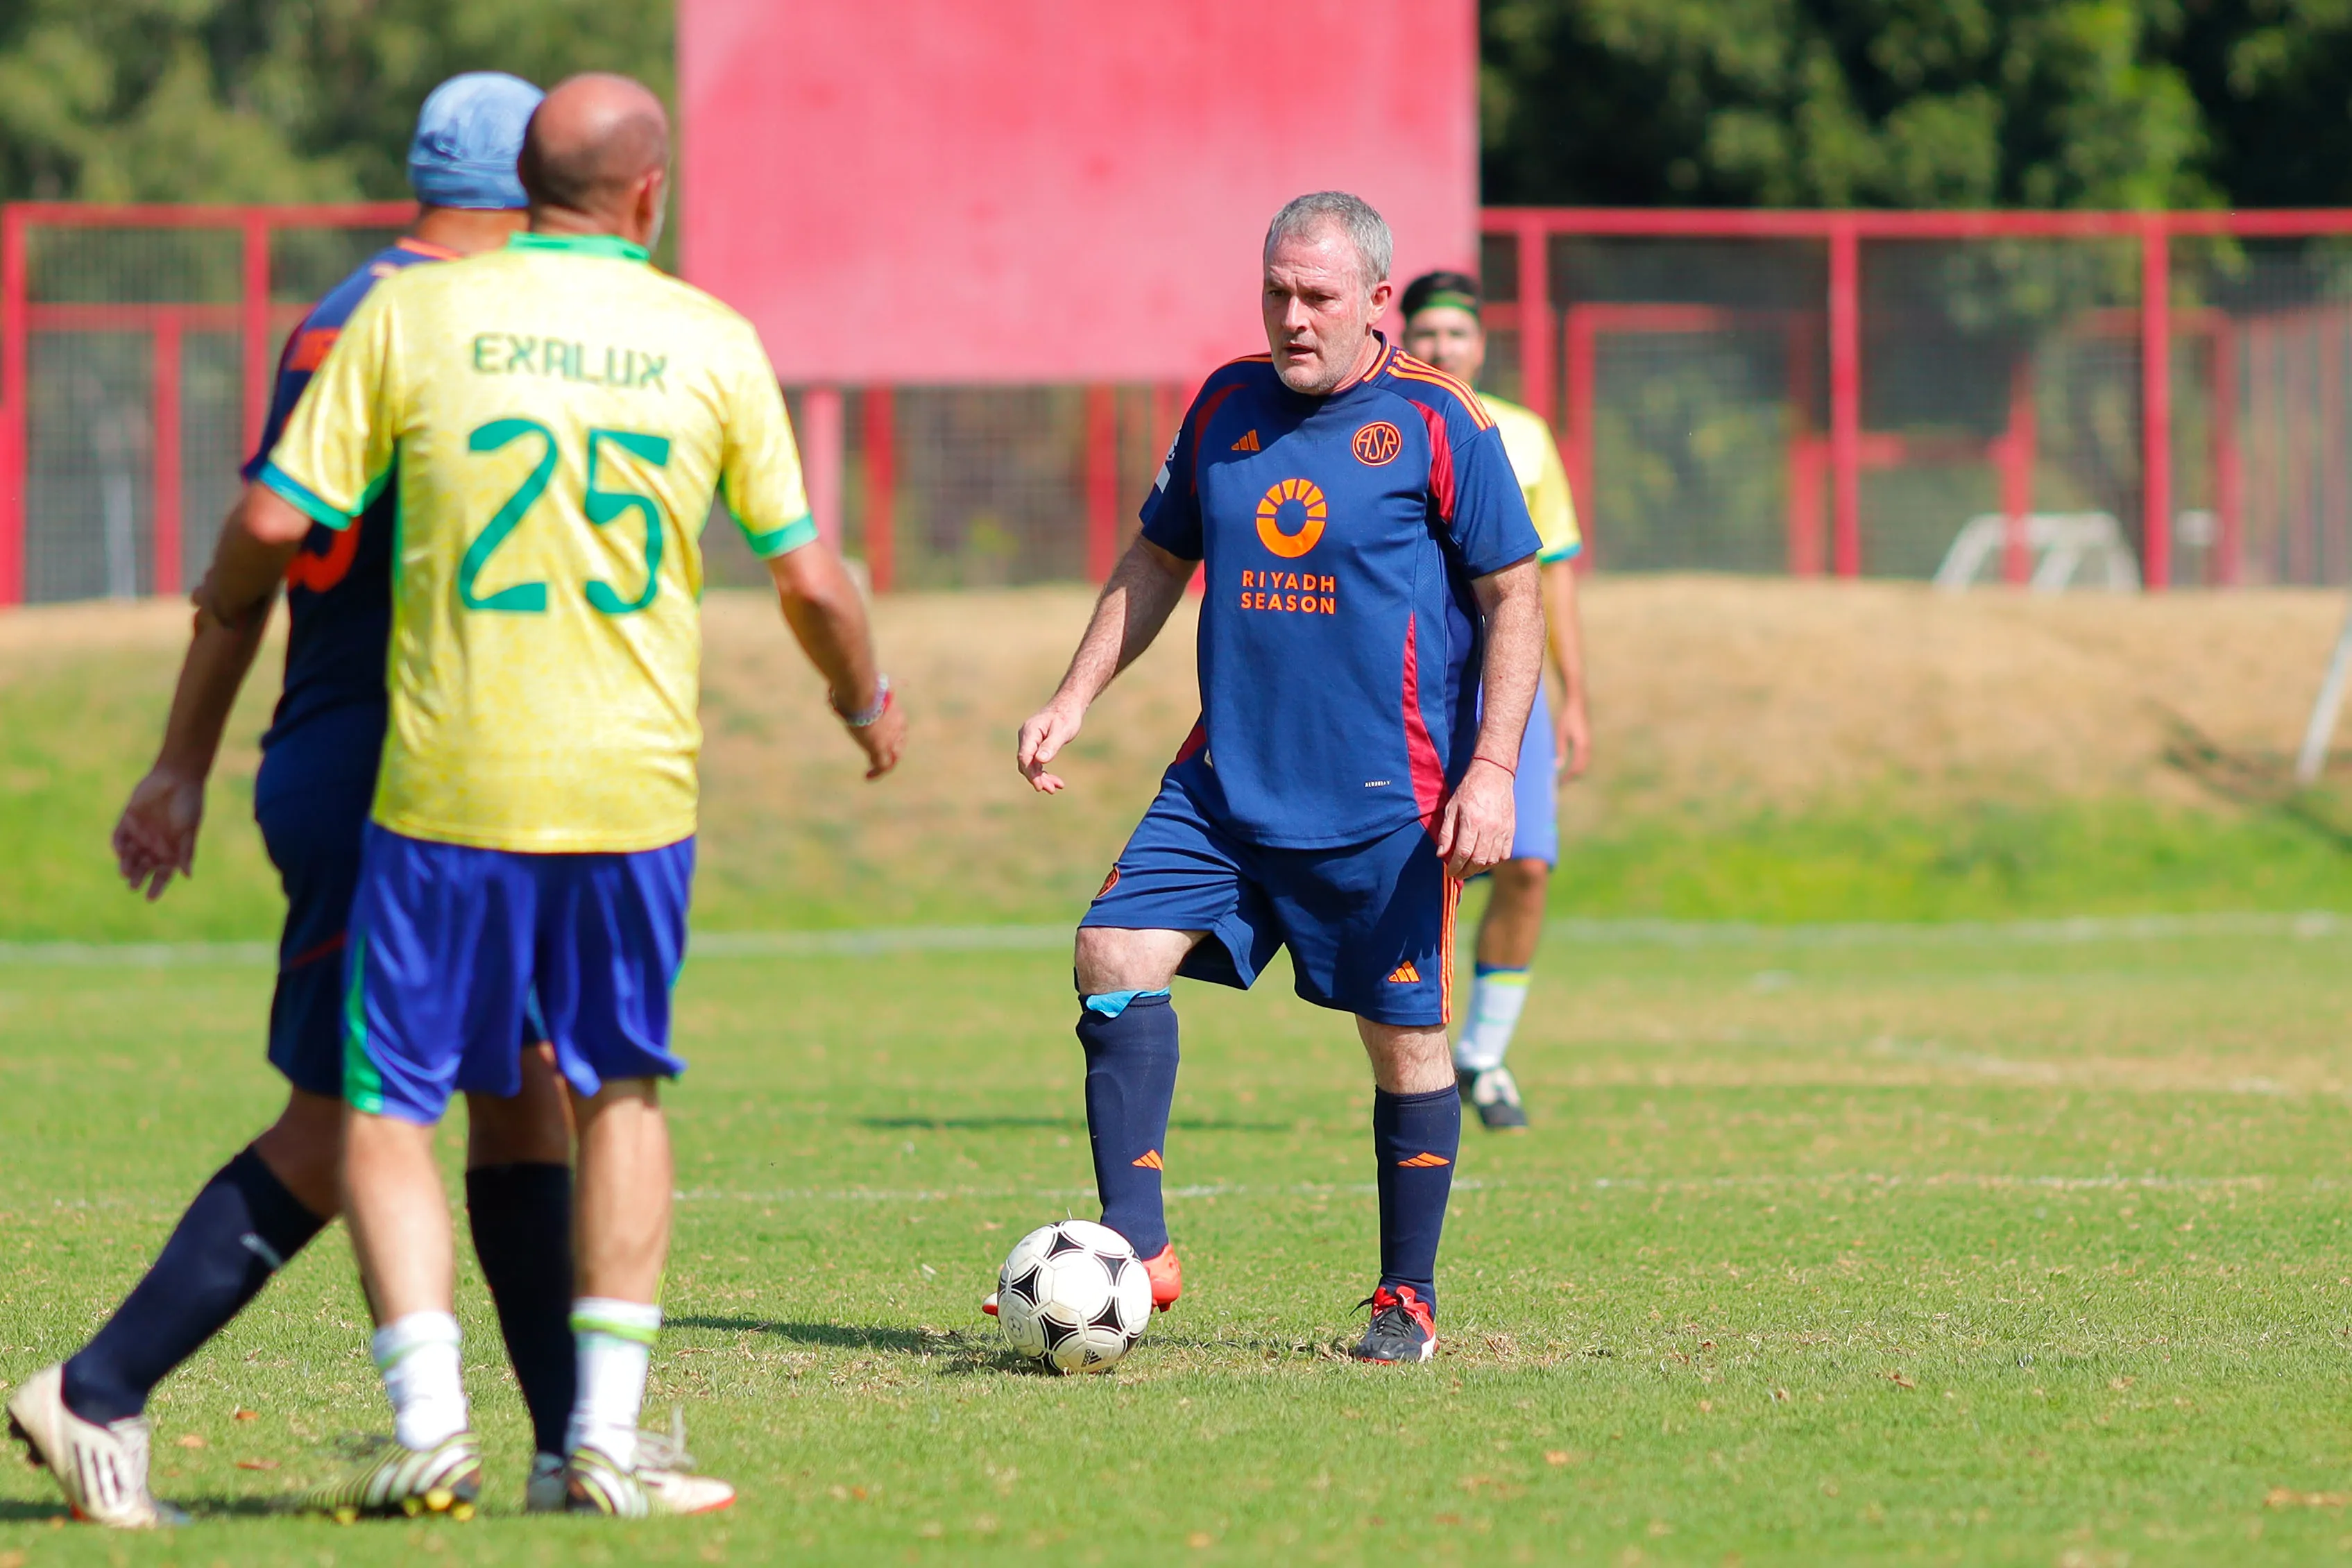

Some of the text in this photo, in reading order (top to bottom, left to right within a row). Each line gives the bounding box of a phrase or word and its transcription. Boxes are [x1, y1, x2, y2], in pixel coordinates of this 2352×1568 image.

[473, 332, 667, 393] EXALUX
[1356, 425, 1397, 460] ASR
[459, 418, 671, 613] 25
[1242, 570, 1335, 593] RIYADH
[1241, 592, 1335, 615] SEASON
